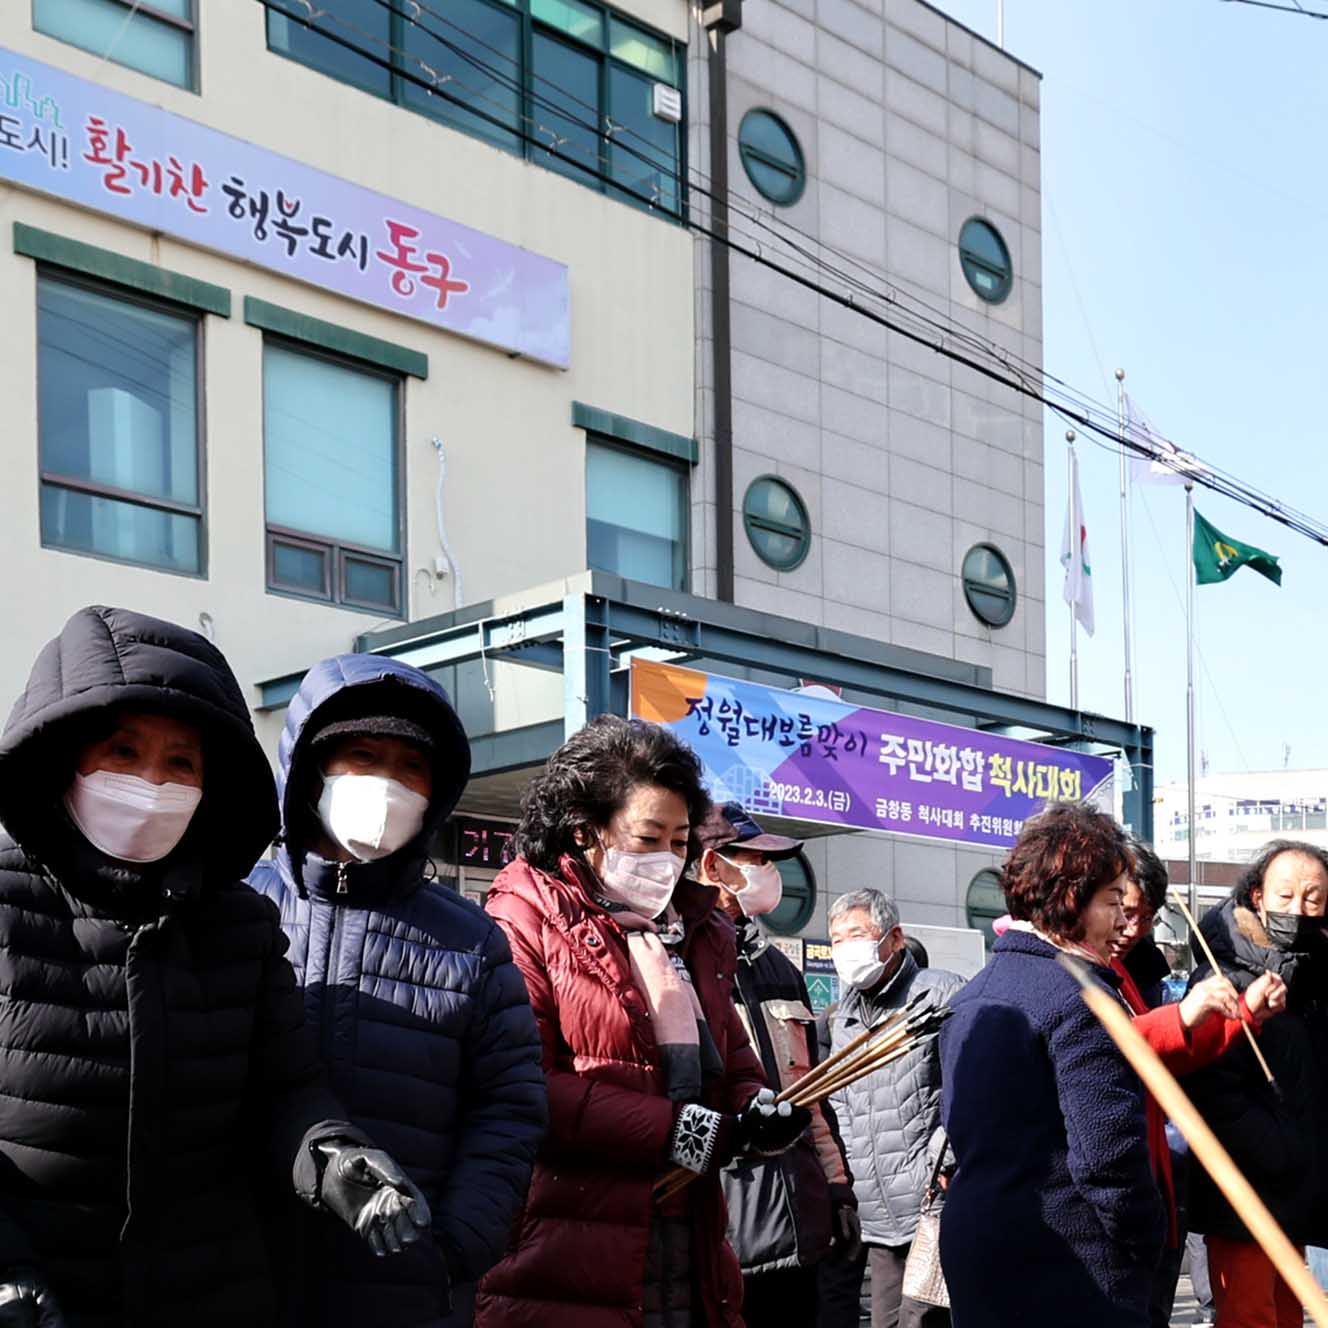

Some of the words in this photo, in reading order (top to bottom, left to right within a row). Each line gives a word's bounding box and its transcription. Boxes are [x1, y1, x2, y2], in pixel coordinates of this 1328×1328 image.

[82, 115, 209, 213] 활기찬
[221, 176, 369, 271] 행복도시
[376, 219, 469, 310] 동구
[686, 698, 868, 761] 정월대보름맞이
[879, 733, 984, 791] 주민화합
[987, 753, 1081, 801] 척사대회
[769, 780, 851, 813] 2023.2.3.(금)
[875, 798, 913, 822] 금창동
[918, 805, 964, 830] 척사대회
